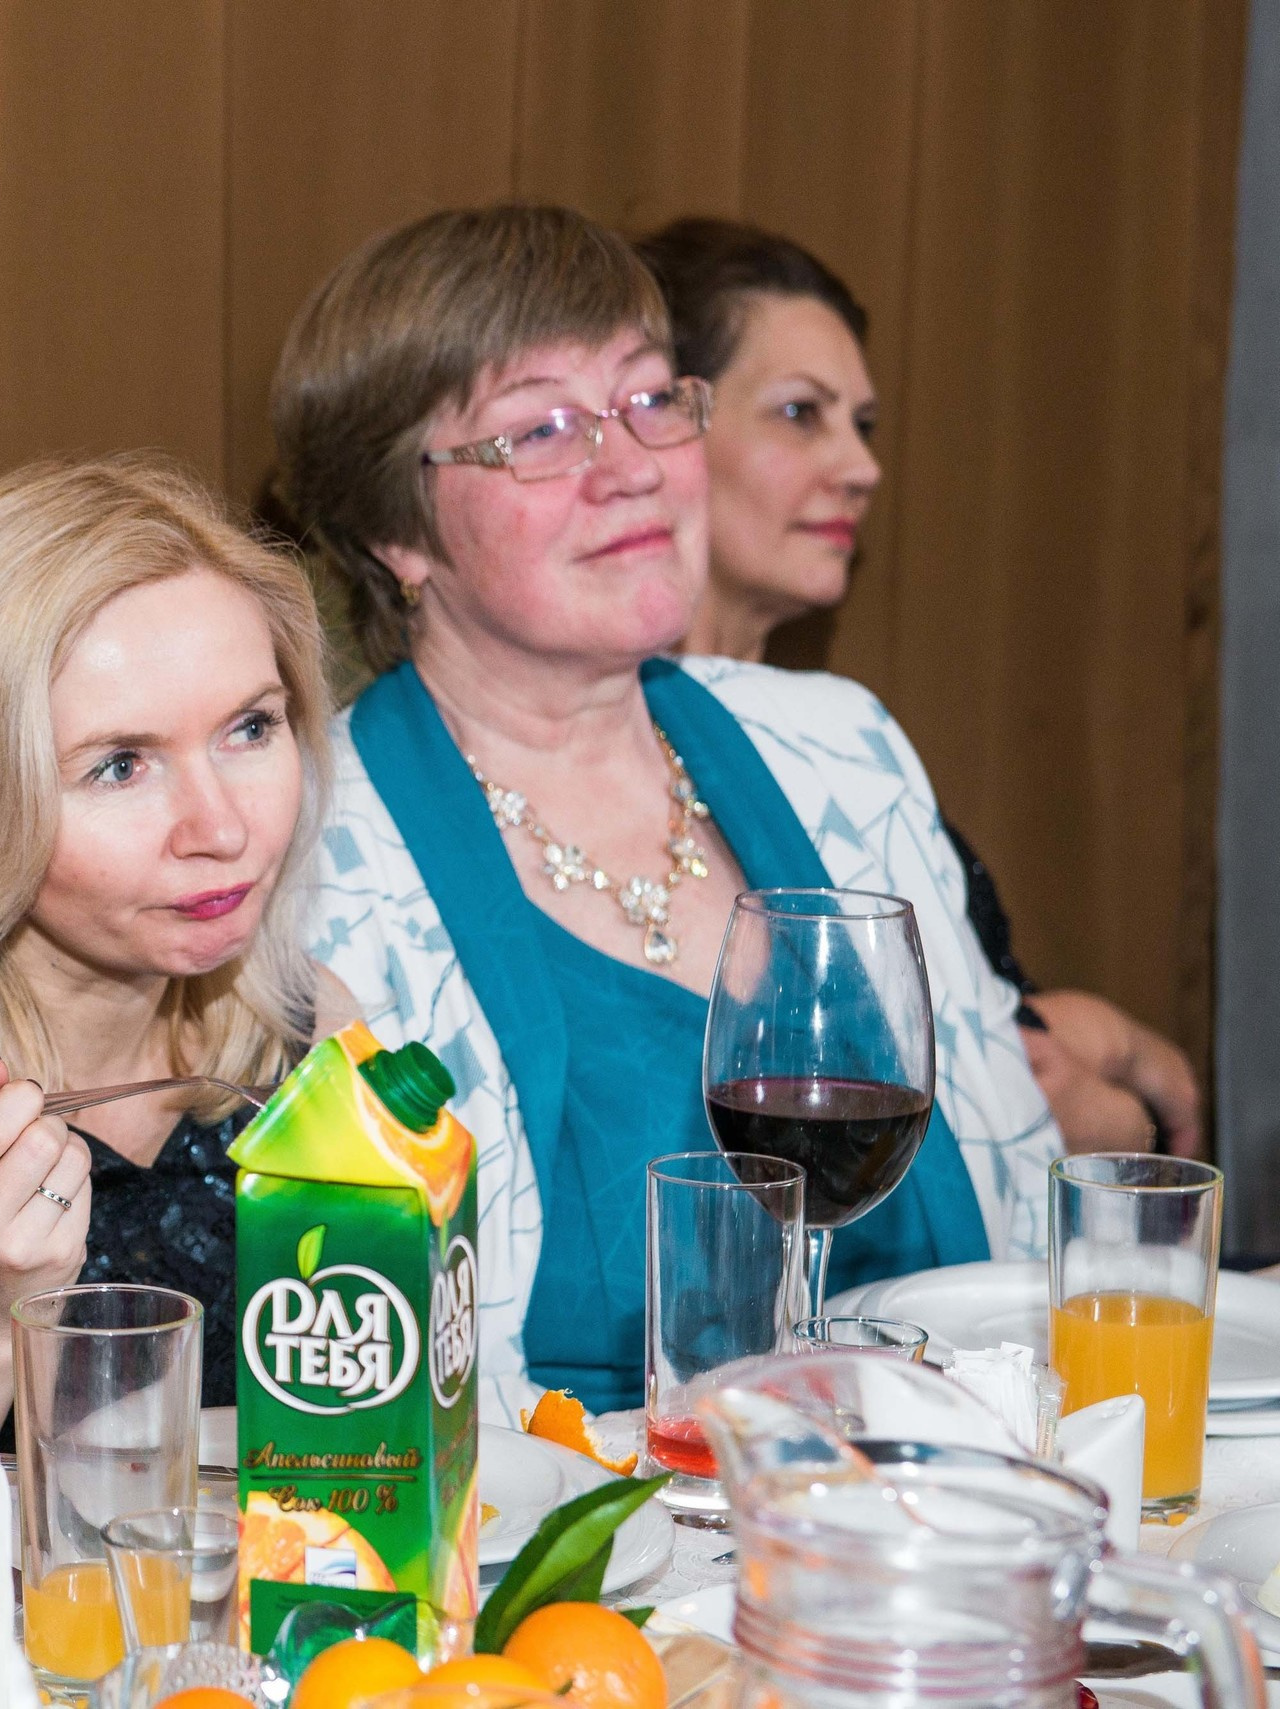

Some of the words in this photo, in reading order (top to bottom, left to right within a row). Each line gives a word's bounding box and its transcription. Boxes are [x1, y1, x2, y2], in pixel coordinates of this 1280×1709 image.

[271, 1279, 391, 1345] ДЛЯ
[265, 1333, 392, 1397] ТЕБЯ
[243, 1441, 422, 1469] Апельсиновый
[269, 1484, 322, 1512] Сок
[327, 1488, 369, 1513] 100
